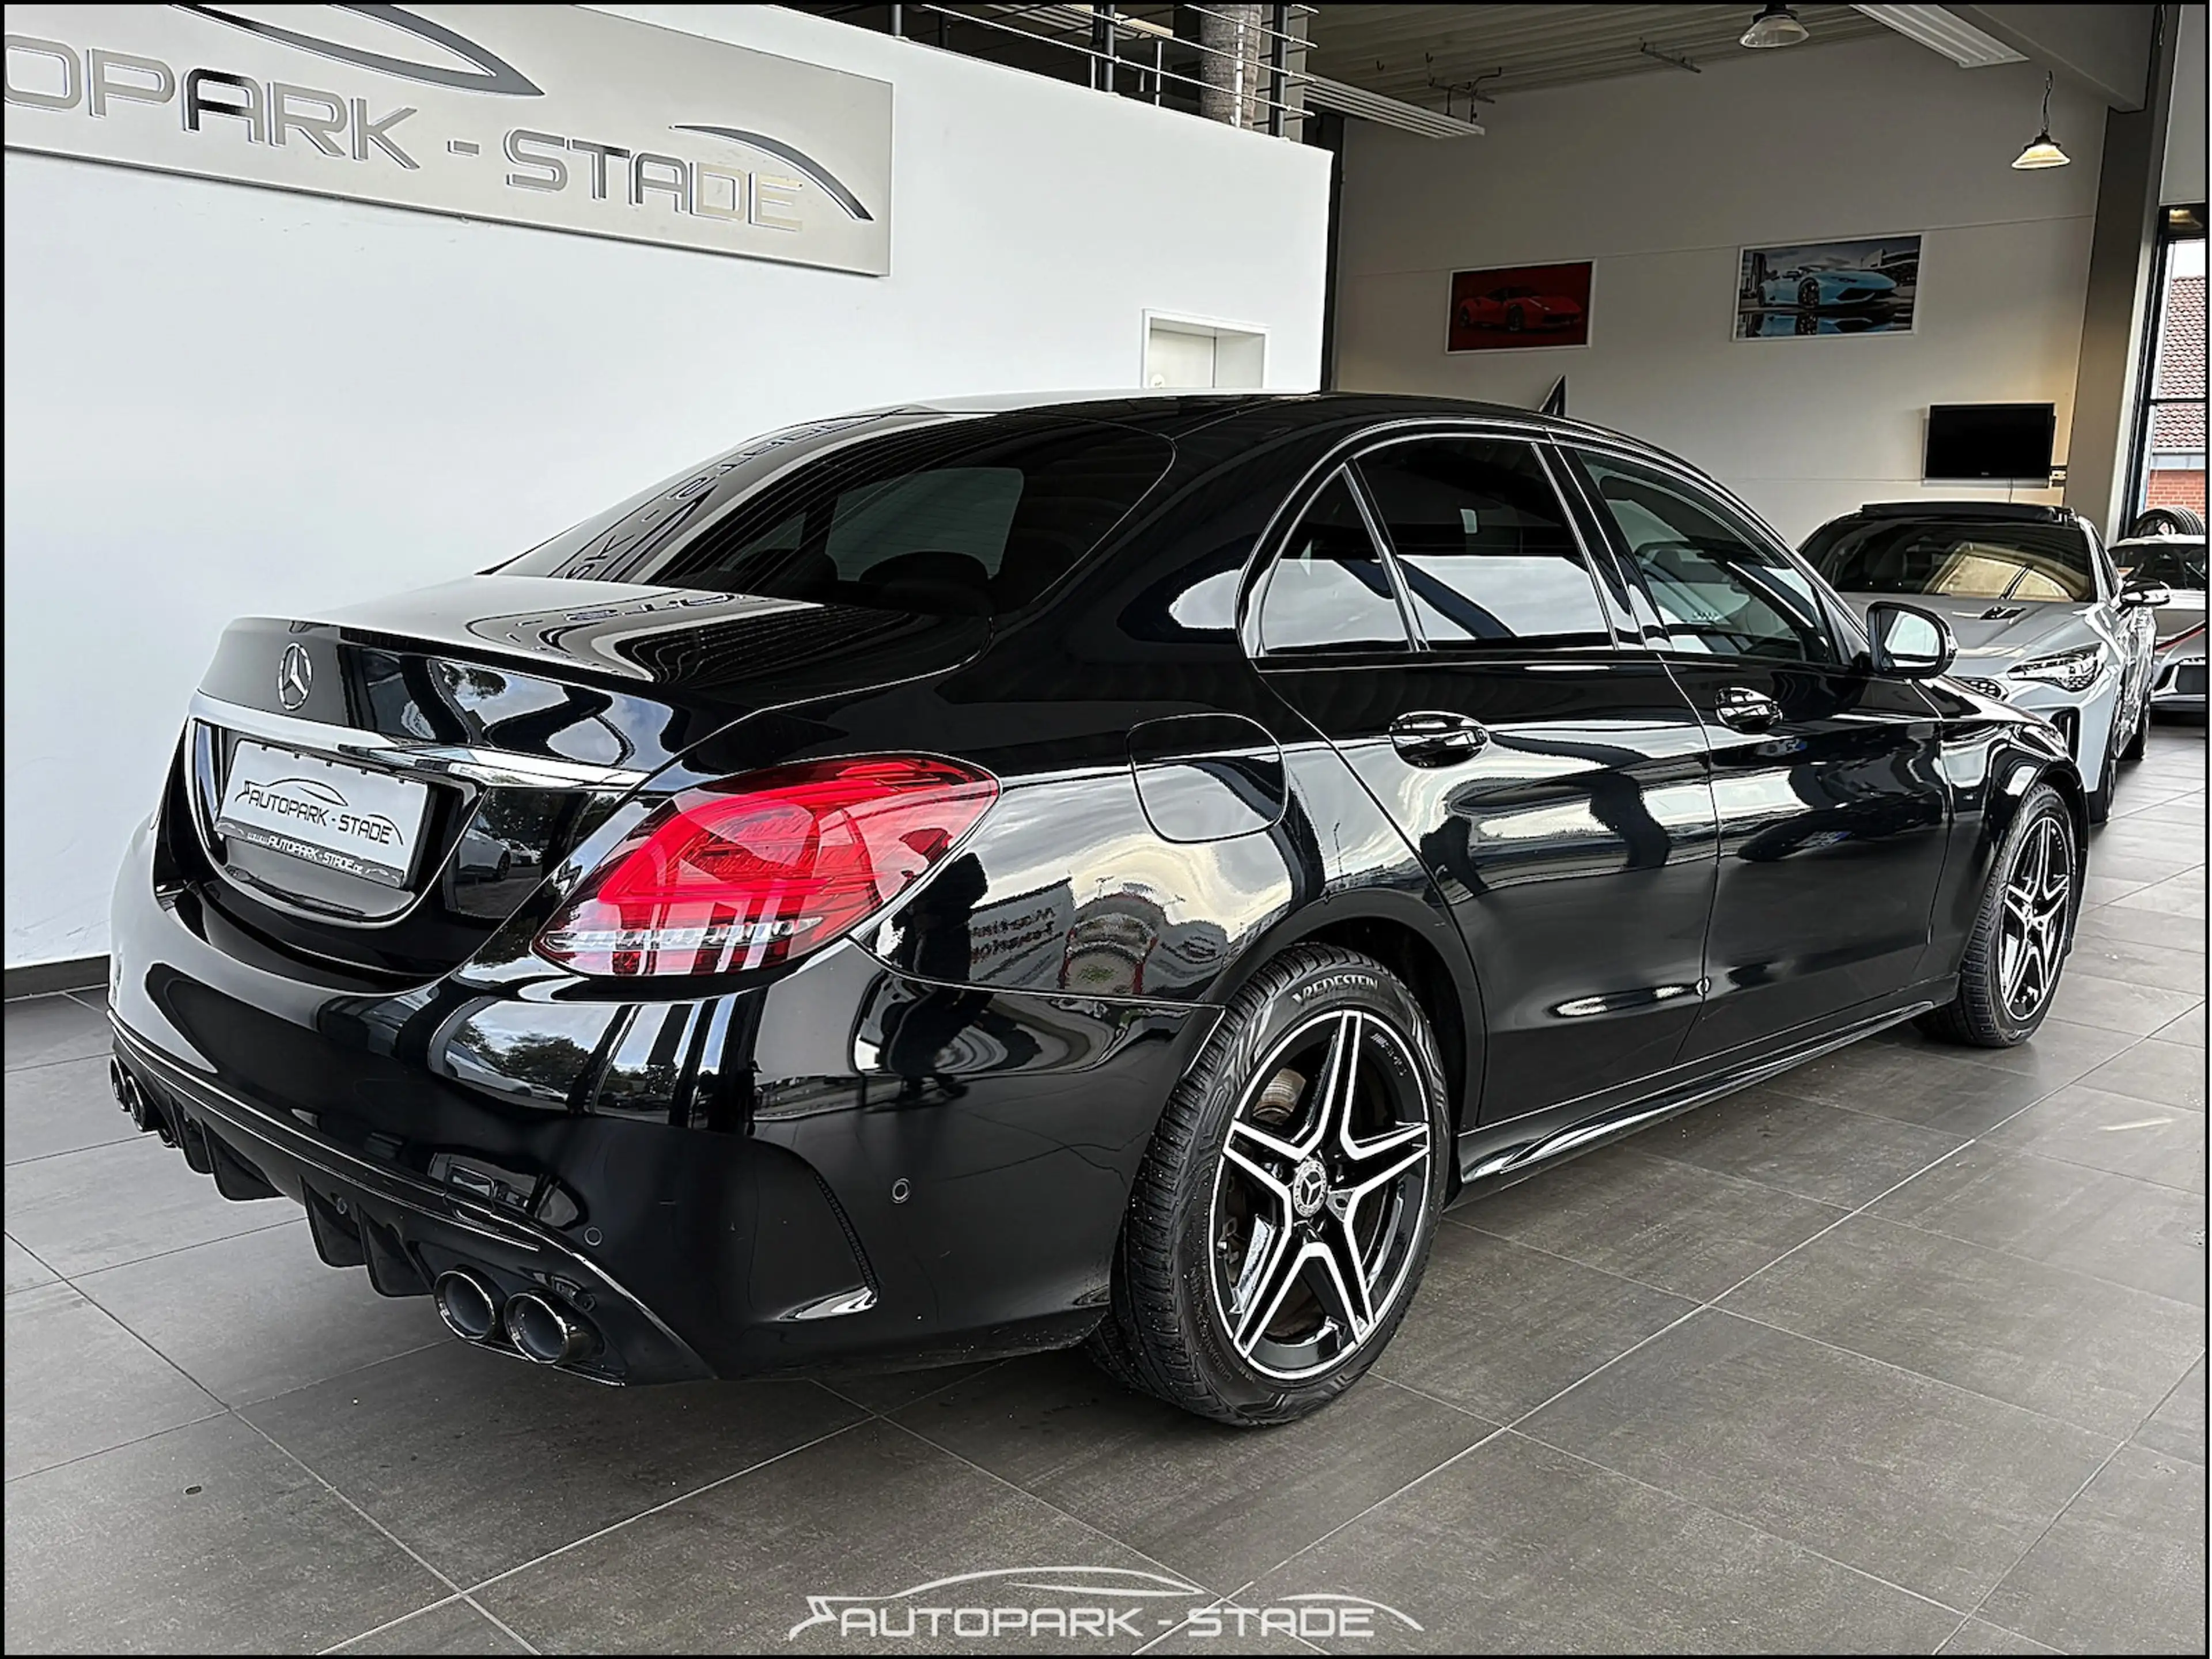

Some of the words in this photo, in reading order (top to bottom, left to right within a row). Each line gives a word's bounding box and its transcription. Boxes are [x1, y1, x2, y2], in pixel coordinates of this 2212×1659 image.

[503, 128, 804, 232] STADE
[248, 789, 330, 827] AUTOPARK
[338, 813, 393, 845] STADE
[1291, 974, 1379, 1005] VREDESTEIN
